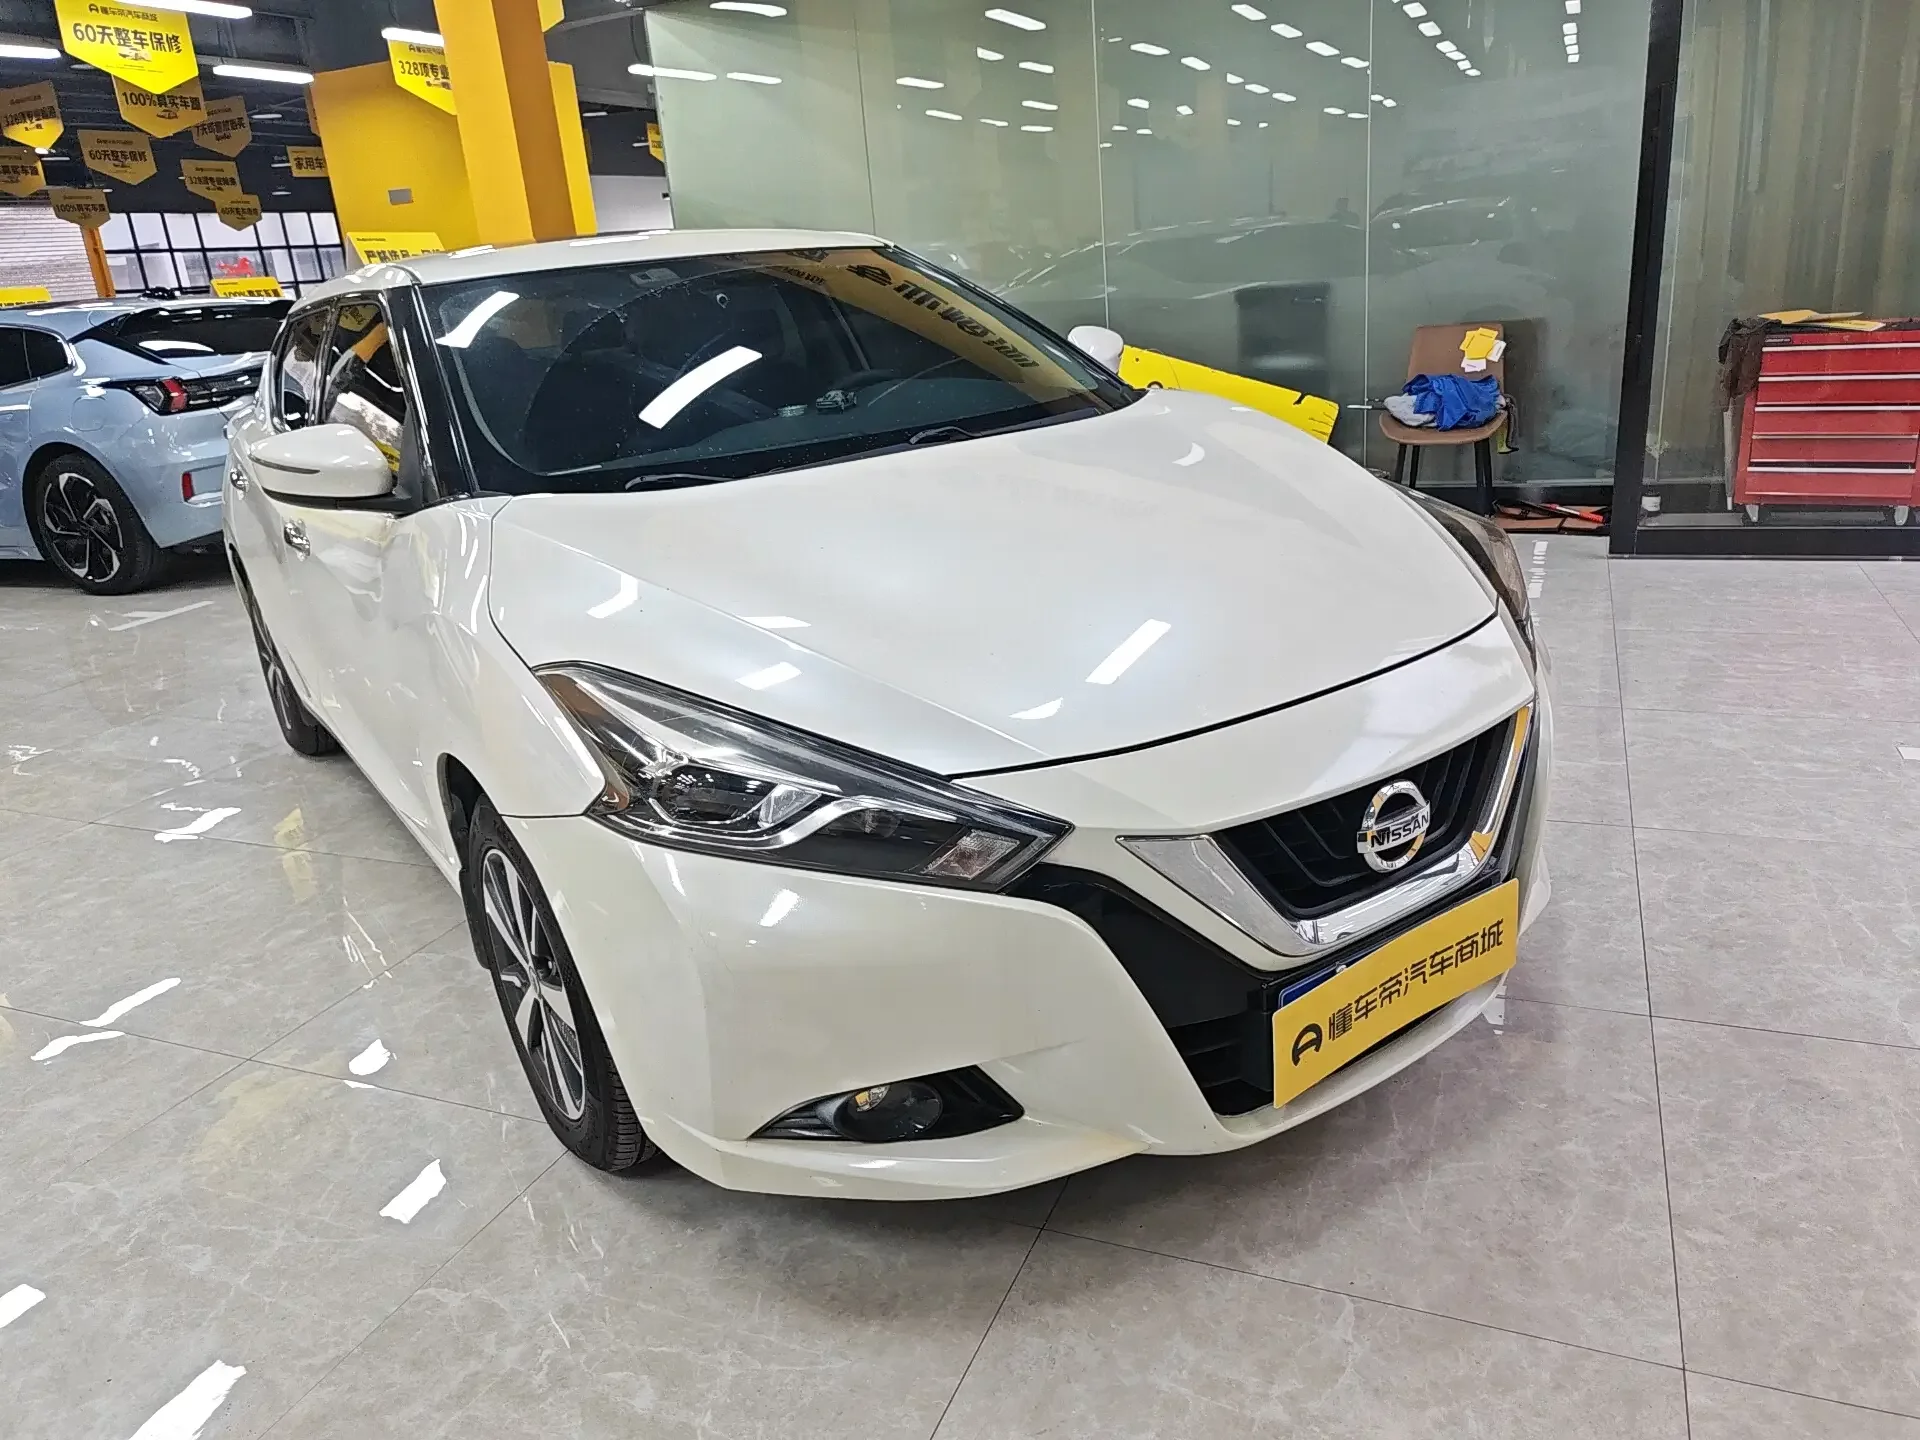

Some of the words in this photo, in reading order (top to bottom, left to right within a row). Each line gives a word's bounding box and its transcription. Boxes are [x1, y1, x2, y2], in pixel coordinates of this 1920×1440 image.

[73, 22, 183, 54] 60天整车保修
[88, 149, 148, 163] 60天整车保修
[1370, 811, 1430, 849] NISSAN
[1328, 917, 1505, 1042] 懂车帝汽车商城
